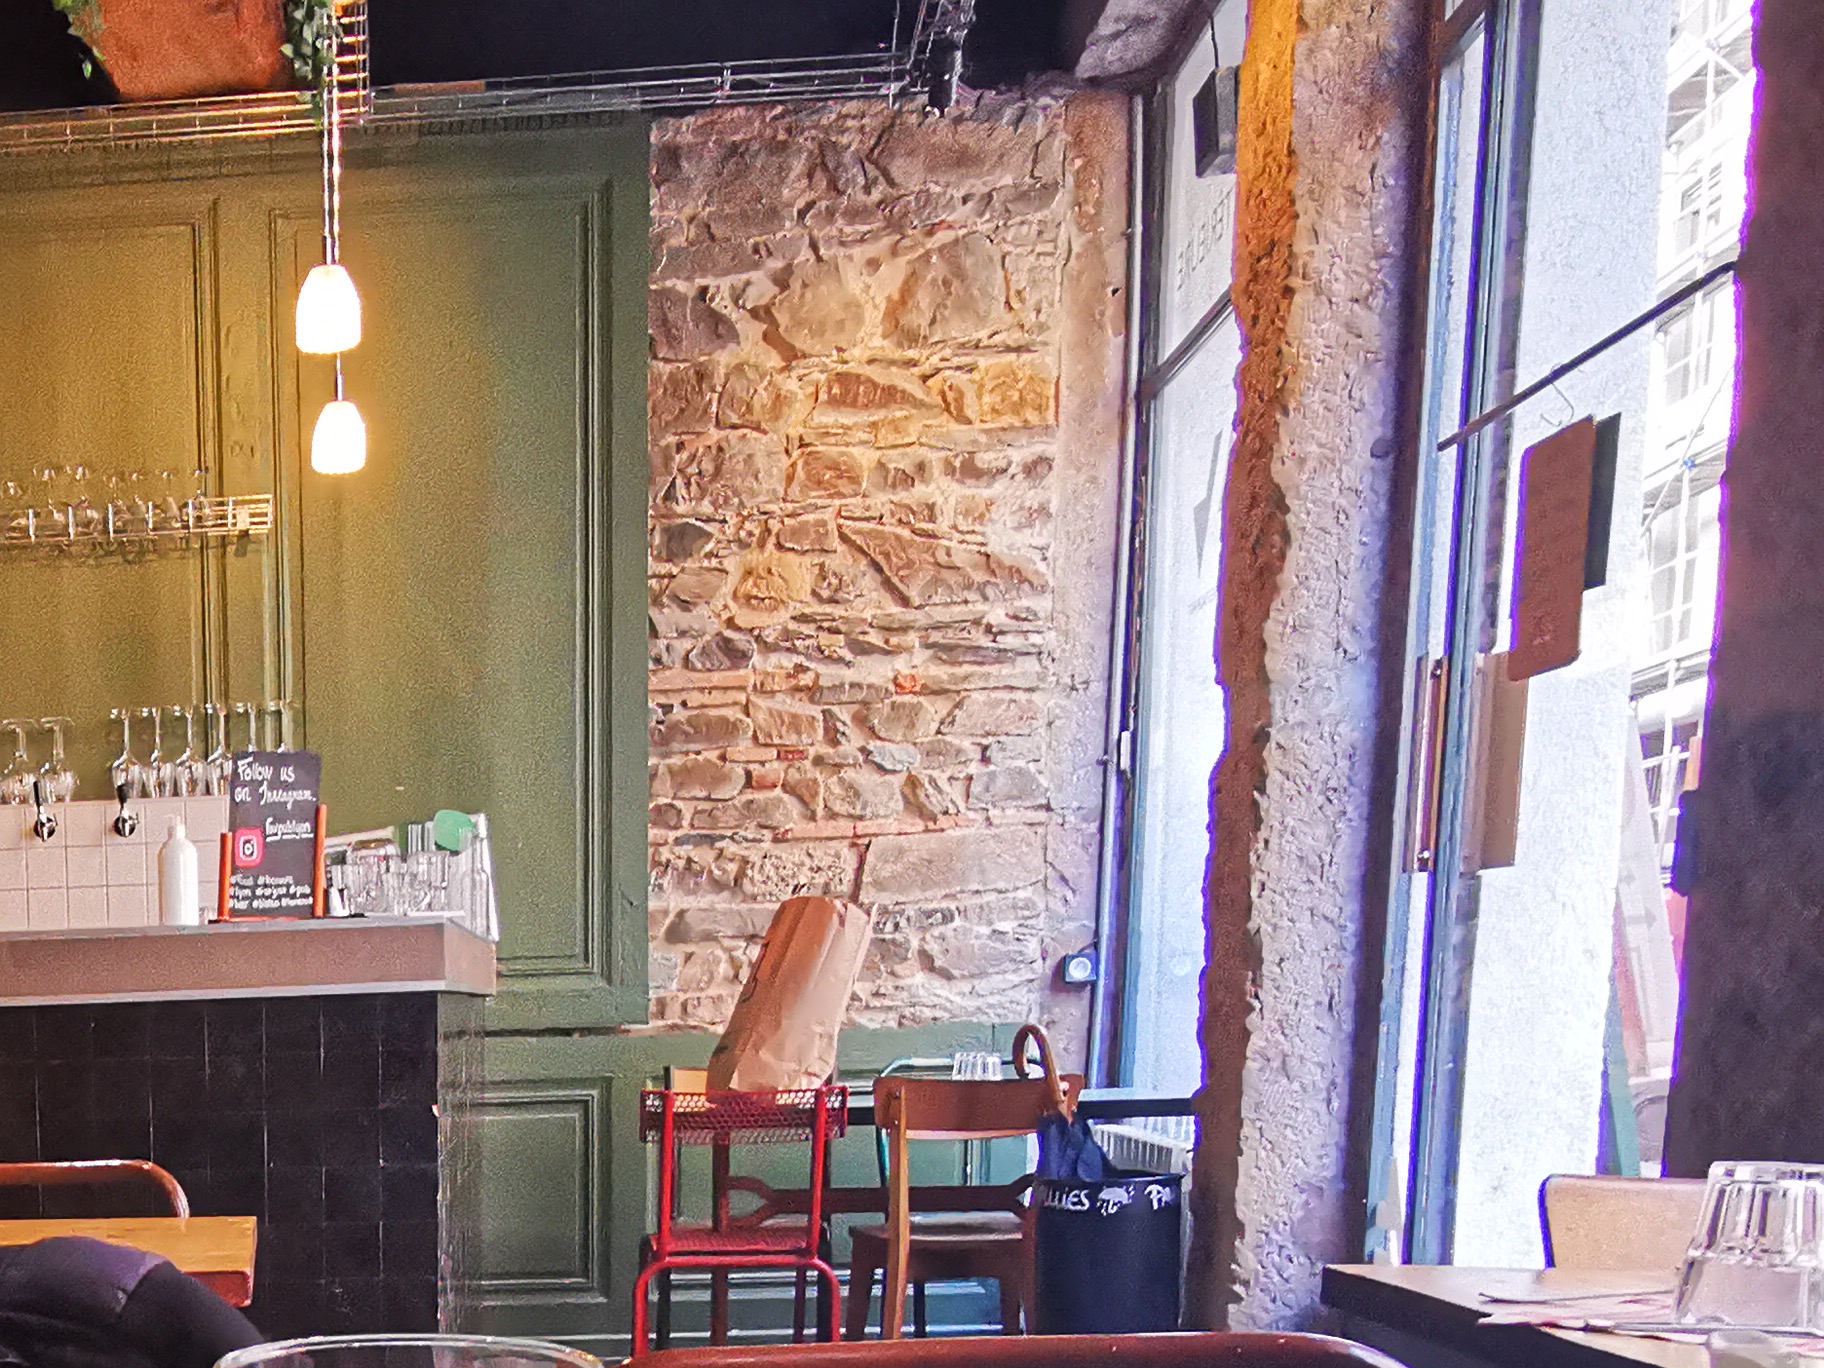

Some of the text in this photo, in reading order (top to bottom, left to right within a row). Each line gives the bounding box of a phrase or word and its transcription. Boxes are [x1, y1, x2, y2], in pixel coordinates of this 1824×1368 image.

[237, 756, 296, 782] Follow us
[234, 786, 252, 802] on
